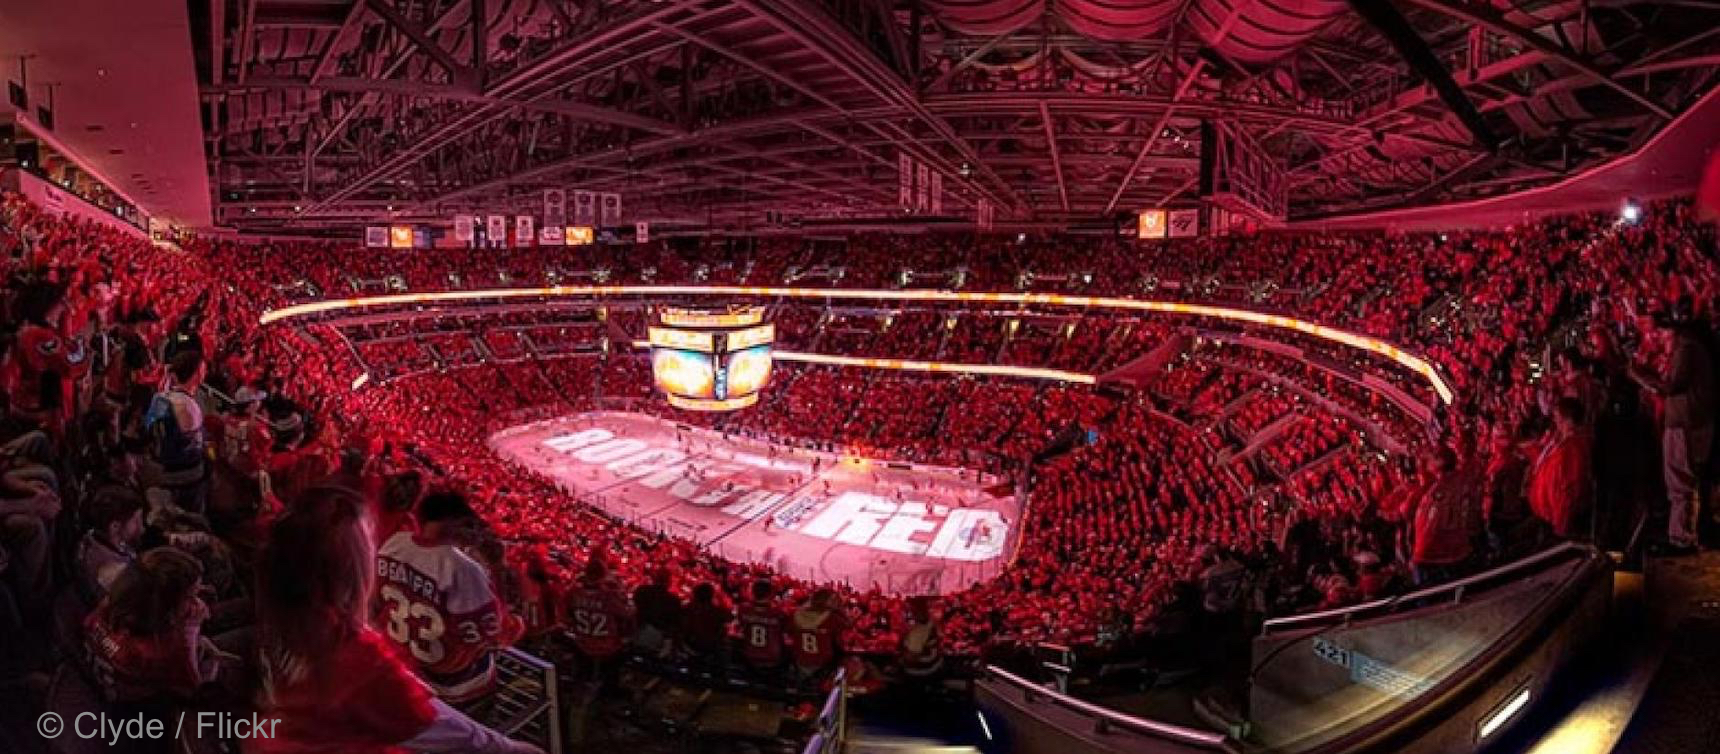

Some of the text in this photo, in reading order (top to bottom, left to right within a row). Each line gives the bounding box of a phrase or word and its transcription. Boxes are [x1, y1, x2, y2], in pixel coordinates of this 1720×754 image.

[800, 491, 1009, 562] RED
[380, 584, 445, 663] 33
[1313, 639, 1348, 666] 421
